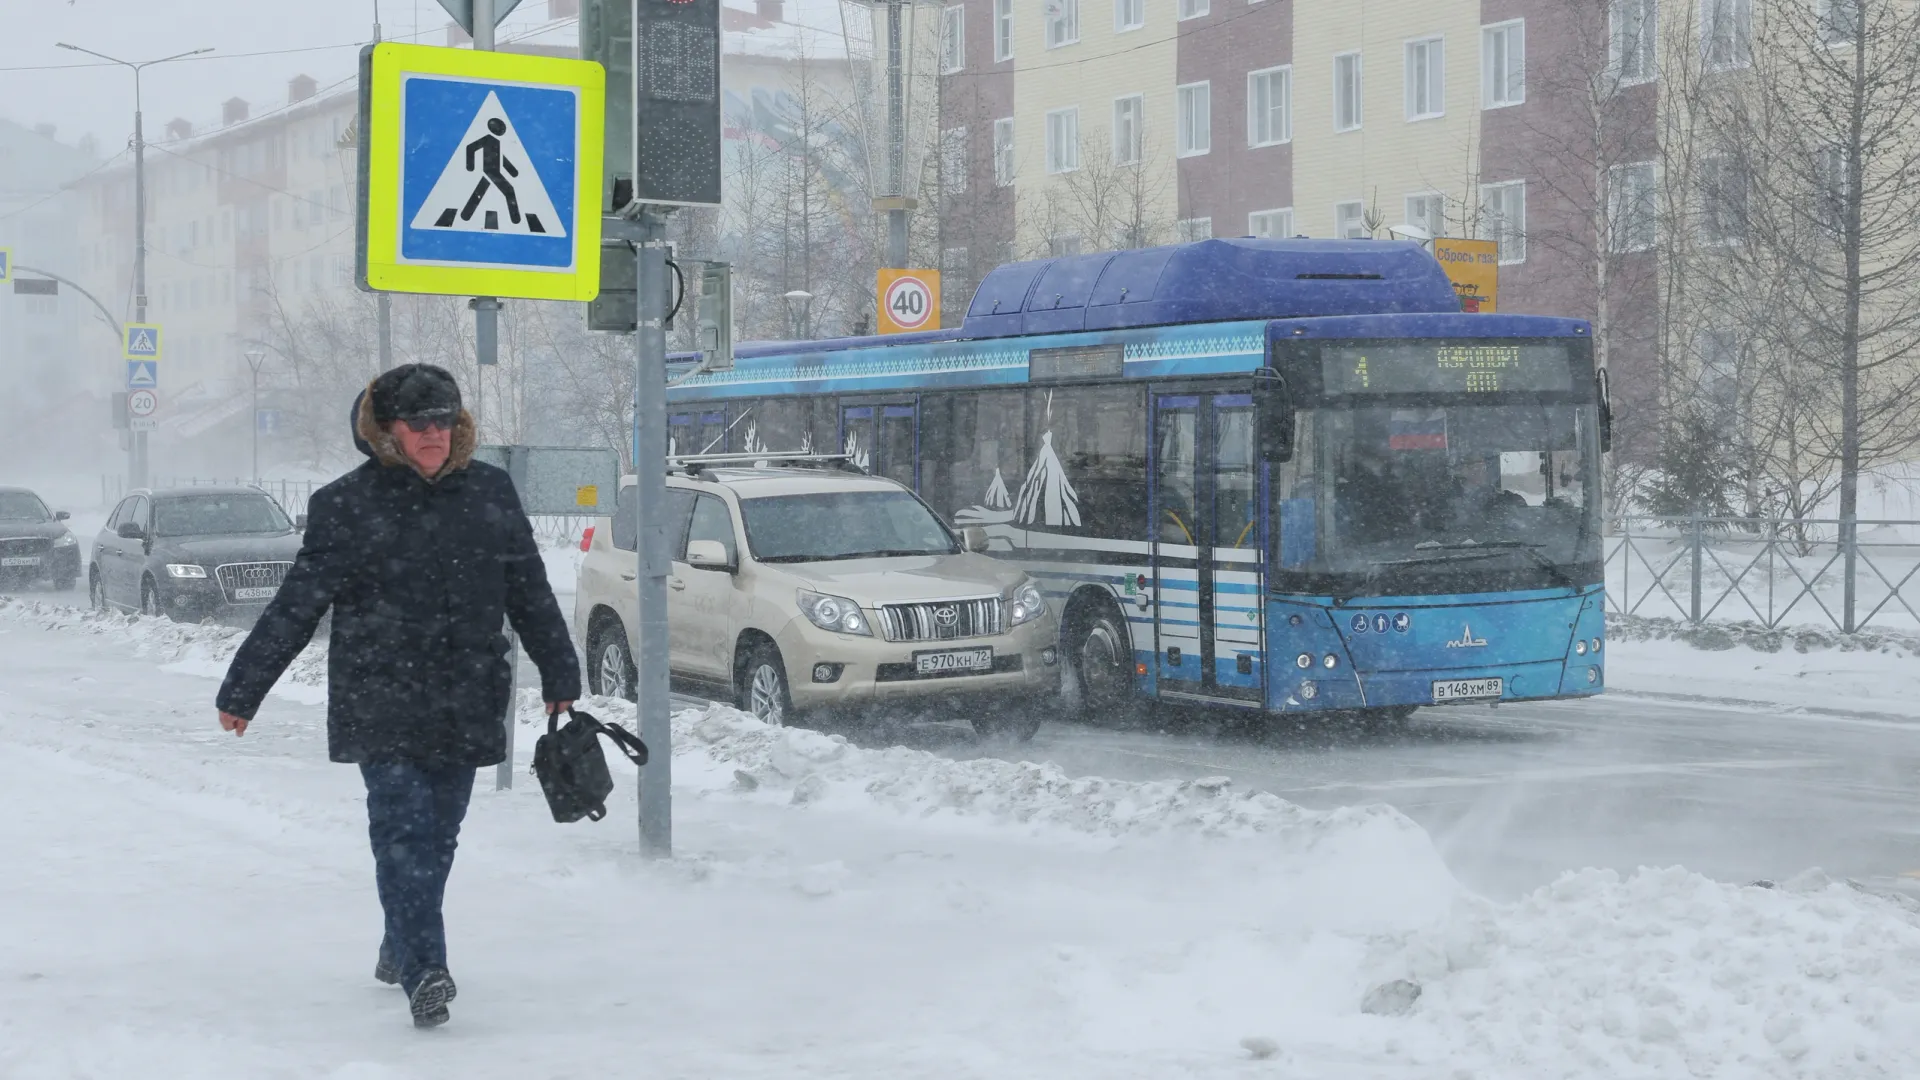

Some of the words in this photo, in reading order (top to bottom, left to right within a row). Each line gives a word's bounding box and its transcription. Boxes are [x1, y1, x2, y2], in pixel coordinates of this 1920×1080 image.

[1437, 247, 1474, 264] Сбрось
[893, 290, 922, 315] 40
[134, 397, 151, 409] 20
[975, 651, 987, 662] 72
[1487, 680, 1499, 691] 89
